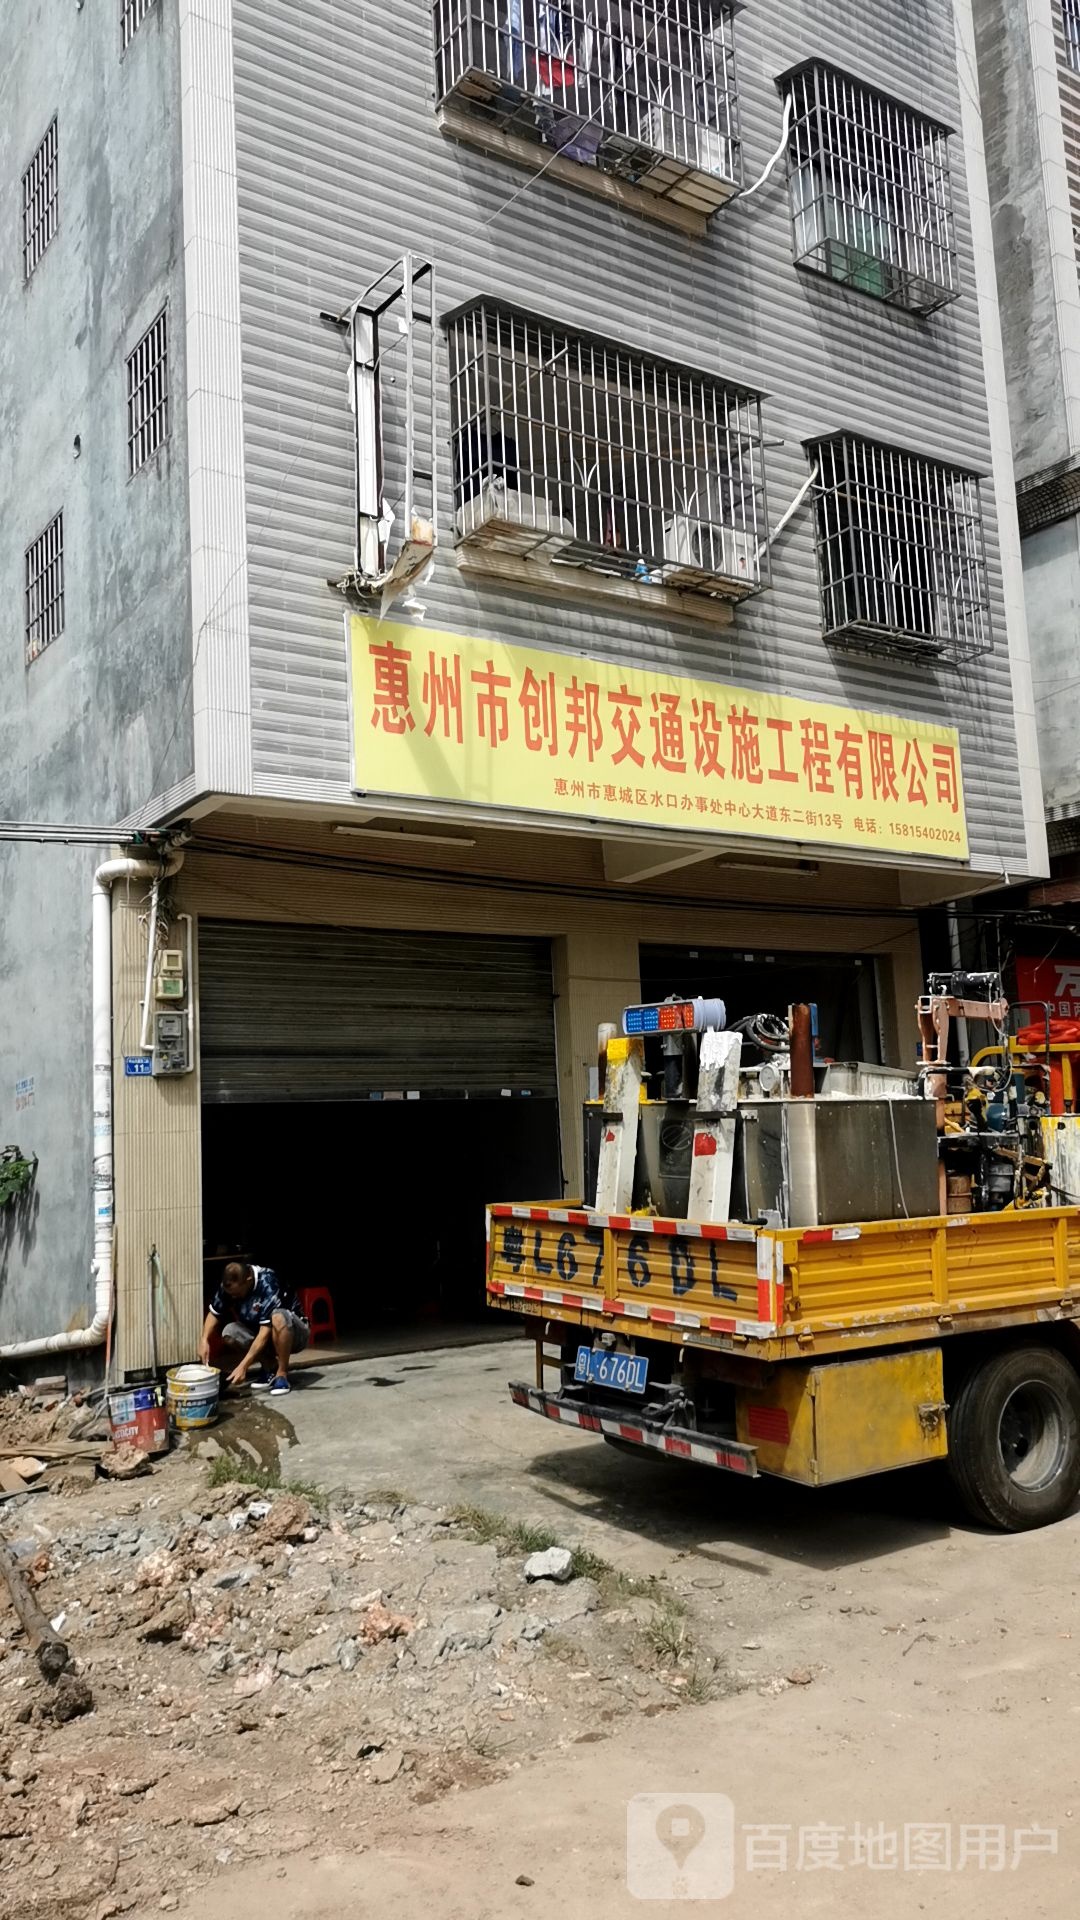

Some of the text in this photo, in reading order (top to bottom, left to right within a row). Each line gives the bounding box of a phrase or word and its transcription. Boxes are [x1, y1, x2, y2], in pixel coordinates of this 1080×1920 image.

[369, 641, 961, 814] 惠州市创邦交通设施工程有限公司
[554, 778, 843, 830] 惠州市惠城区水口办事处中心大道东二街13号
